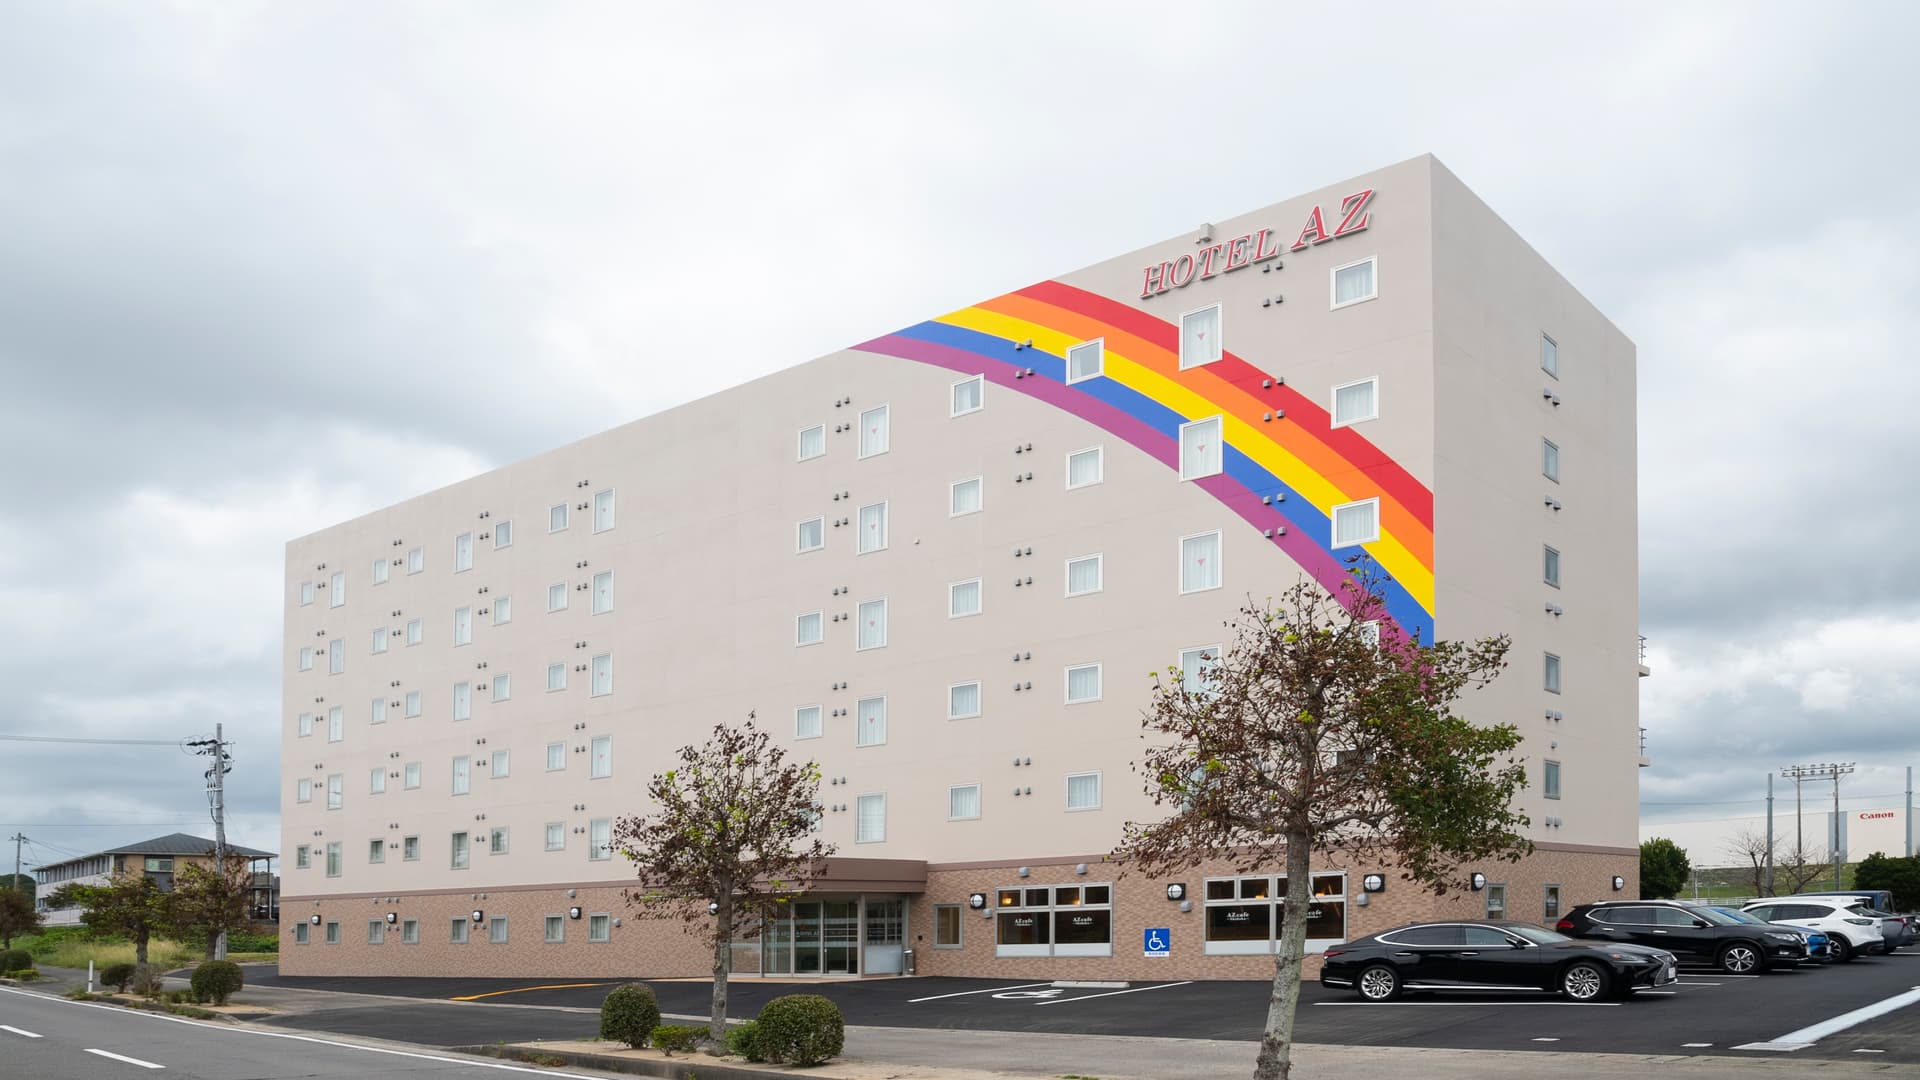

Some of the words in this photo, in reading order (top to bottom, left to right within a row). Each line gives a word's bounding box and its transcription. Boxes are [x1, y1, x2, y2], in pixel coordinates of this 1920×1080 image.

[1140, 227, 1280, 299] HOTEL
[1290, 188, 1376, 252] AZ
[1859, 812, 1894, 820] Canon
